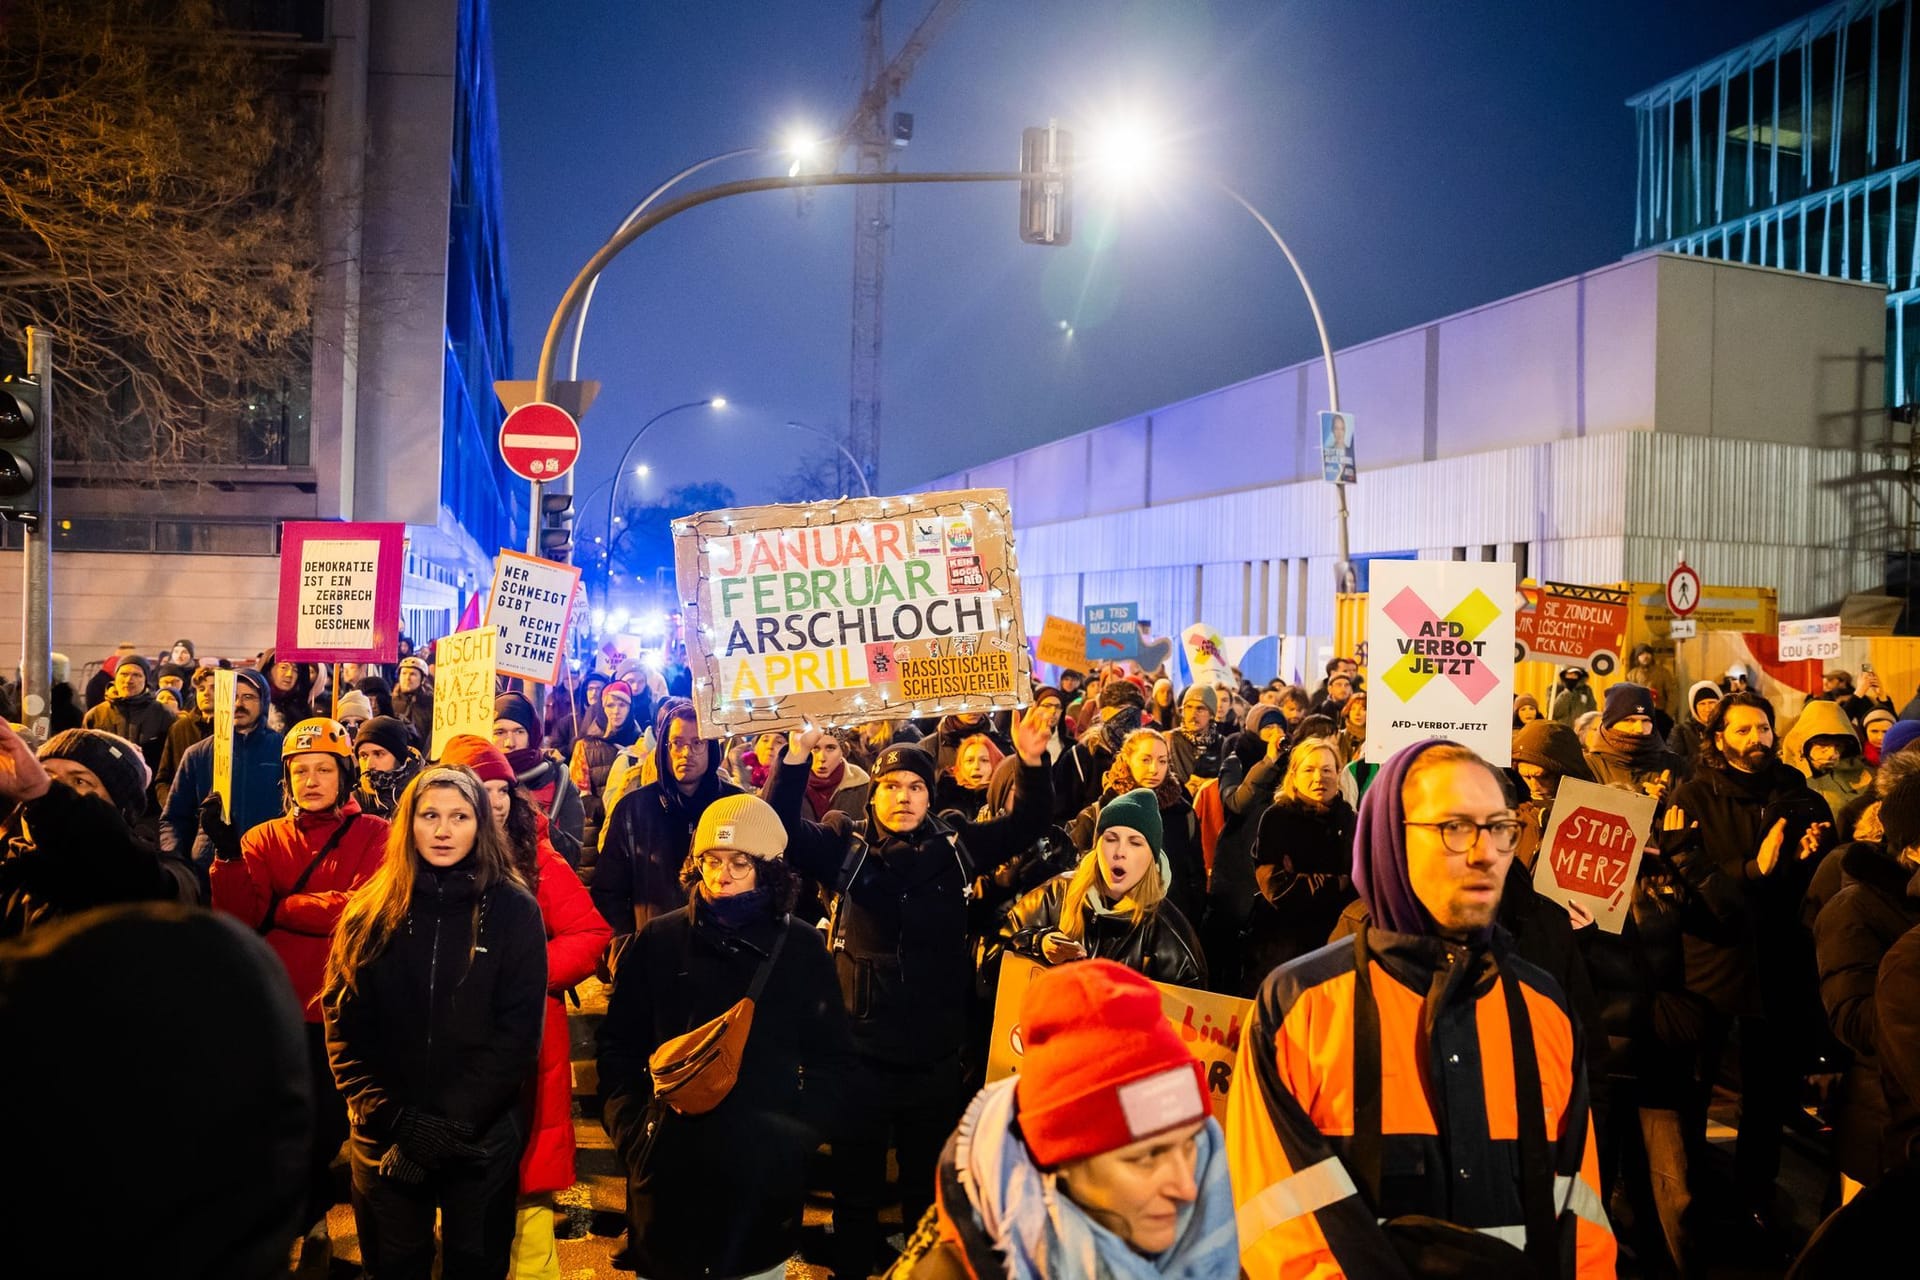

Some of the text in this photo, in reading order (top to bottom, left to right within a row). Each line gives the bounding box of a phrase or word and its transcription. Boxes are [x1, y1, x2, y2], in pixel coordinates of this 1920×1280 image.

[718, 522, 904, 577] JANUAR
[304, 561, 374, 572] DEMOKRATIE
[504, 565, 529, 582] WER
[304, 576, 352, 586] IST EIN
[721, 560, 938, 617] FEBRUAR
[316, 590, 372, 601] ZERBRECH
[501, 580, 567, 606] SCHWEIGT
[302, 604, 343, 615] LICHES
[497, 595, 531, 612] GIBT
[1109, 607, 1129, 618] THIS
[1543, 601, 1560, 618] SIE
[315, 619, 370, 630] GESCHENK
[519, 615, 561, 634] RECHT
[725, 596, 985, 657] ARSCHLOCH
[1419, 620, 1464, 638] AFD
[497, 624, 558, 649] N EINE
[504, 642, 555, 664] STIMME
[1396, 638, 1486, 657] VERBOT
[1535, 637, 1583, 655] FCK NZS
[1782, 642, 1839, 657] CDU & FDP
[731, 649, 867, 700] APRIL
[902, 654, 1008, 678] RASSISTISCHER
[1409, 658, 1475, 675] JETZT
[435, 670, 490, 703] NAZI
[904, 672, 1010, 696] SCHEISSVEREIN
[434, 694, 490, 731] BOTS
[1391, 720, 1488, 731] AFD-VERBOT.JETZT
[1566, 815, 1633, 852] STOPP
